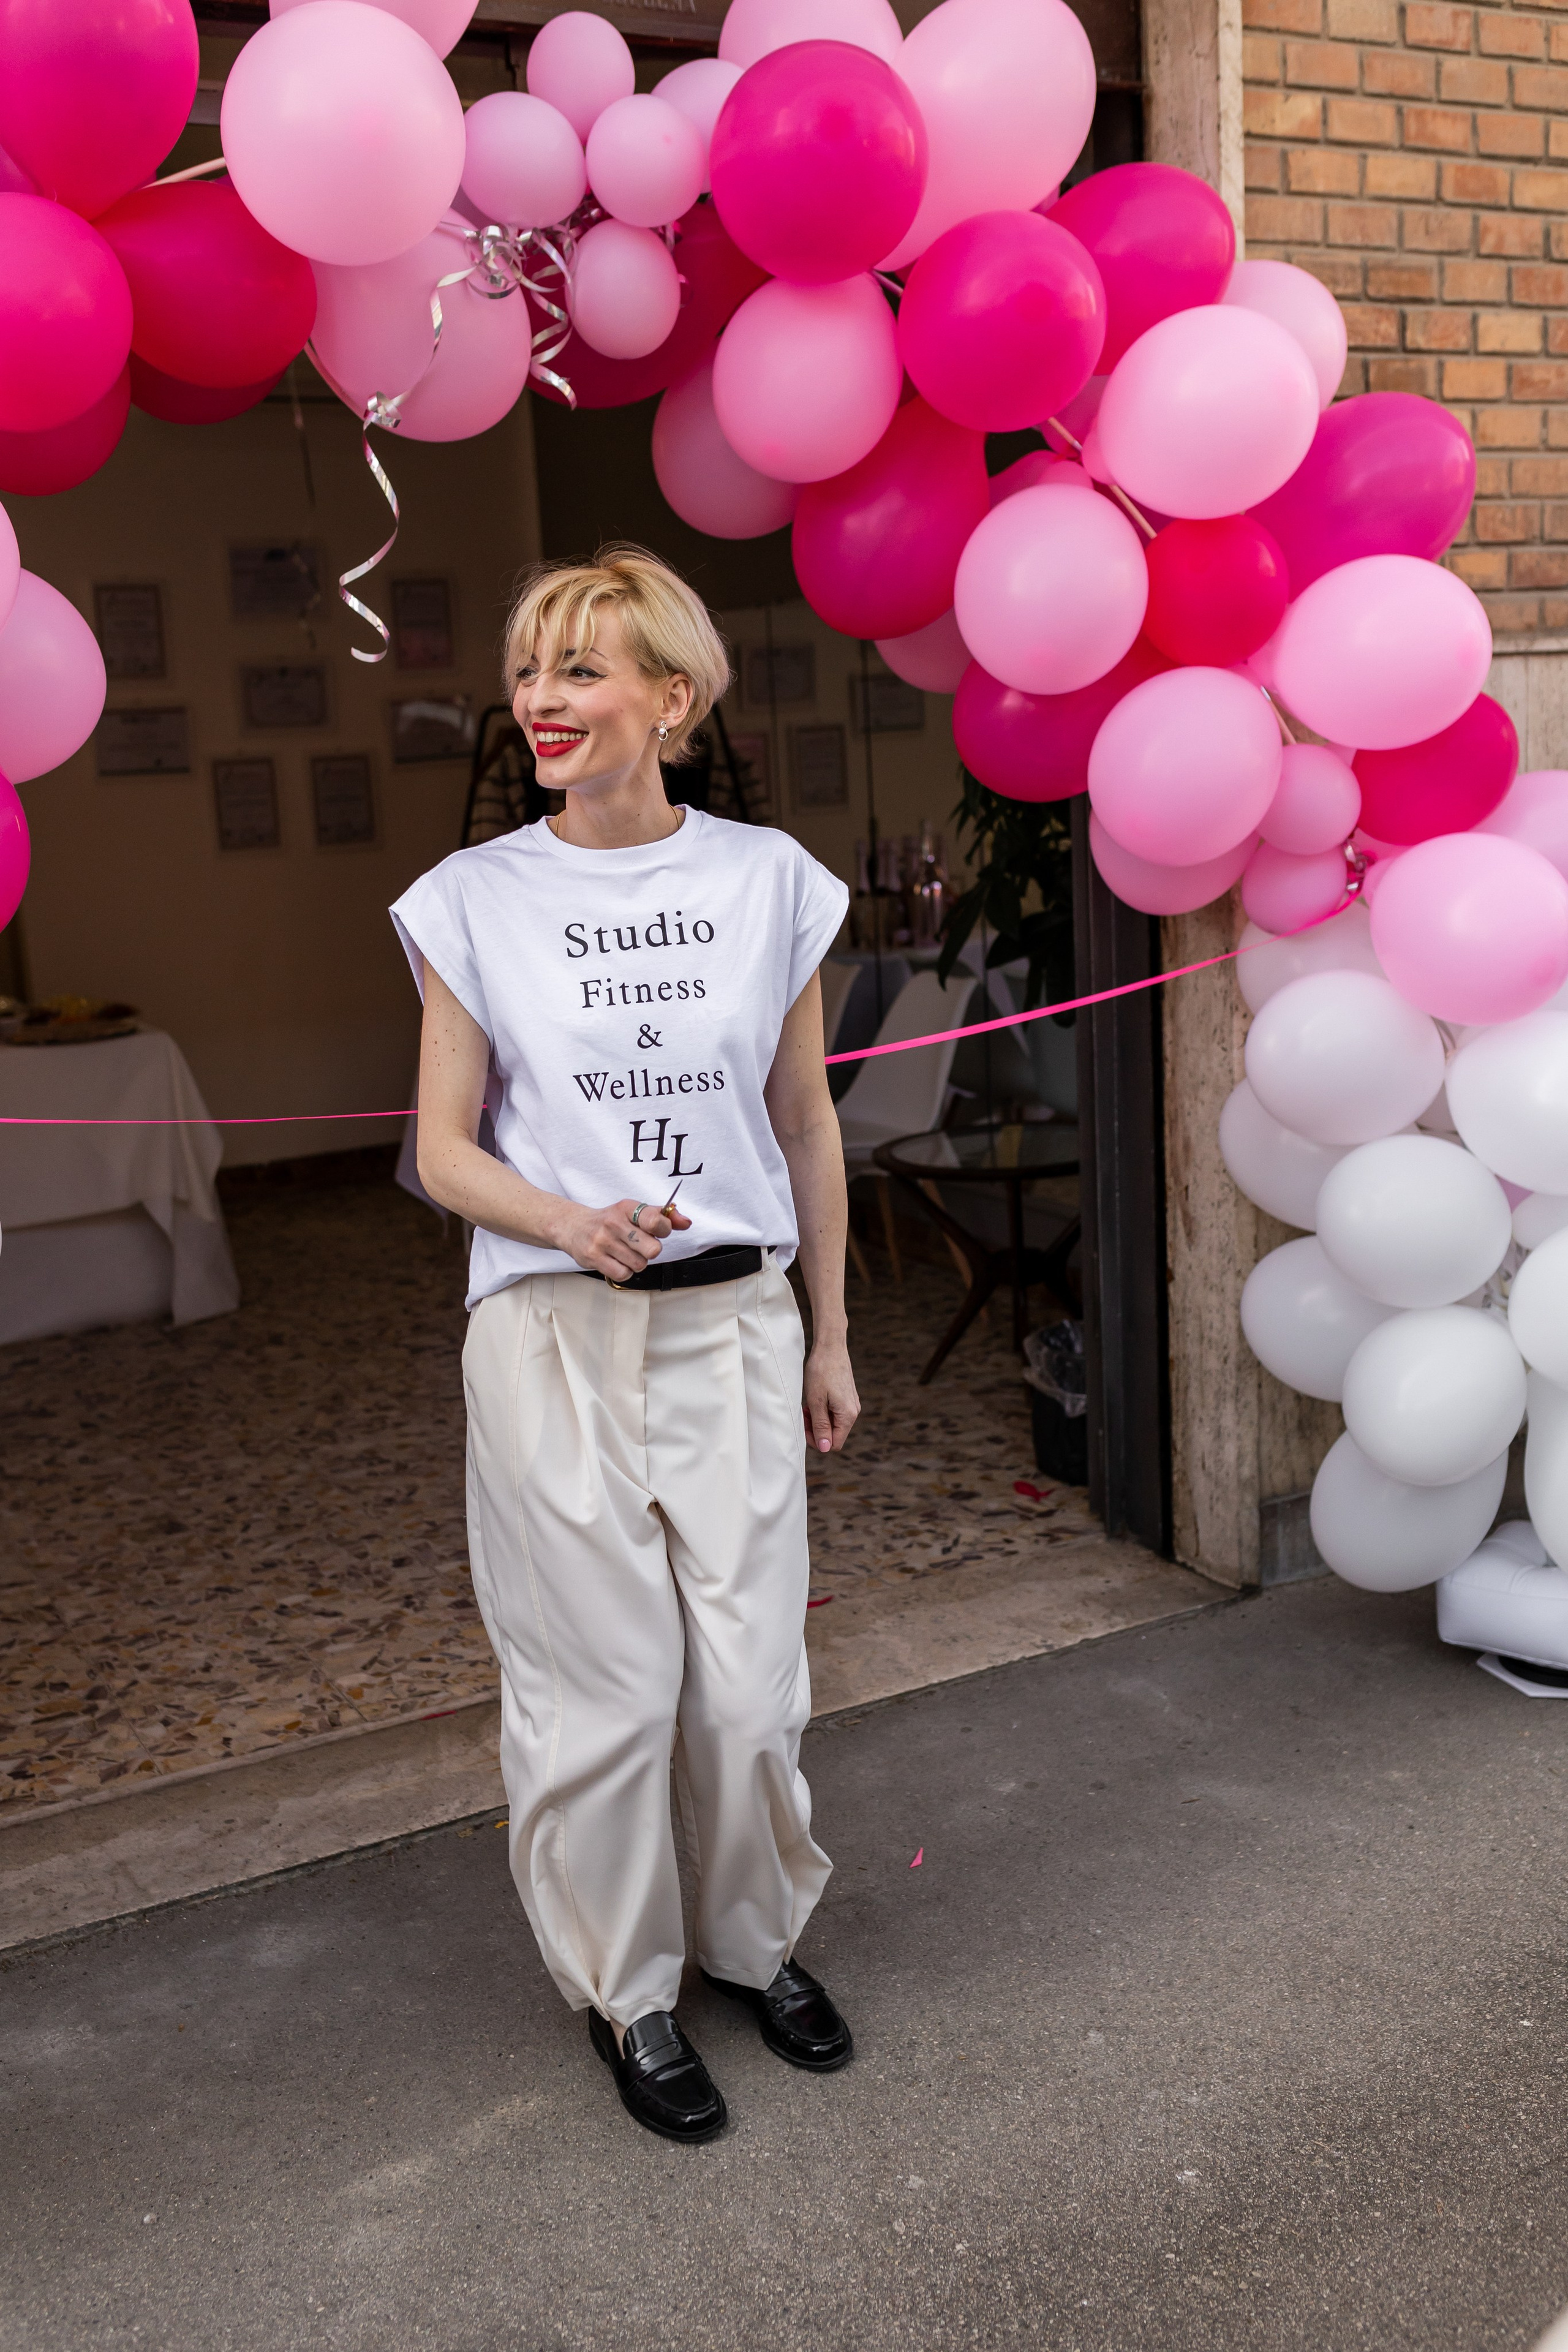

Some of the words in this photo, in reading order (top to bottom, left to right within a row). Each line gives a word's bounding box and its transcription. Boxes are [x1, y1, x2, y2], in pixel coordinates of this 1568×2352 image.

[565, 910, 714, 958] Studio
[579, 978, 706, 1008] Fitness
[637, 1023, 663, 1049] &
[572, 1068, 725, 1102] Wellness
[629, 1118, 704, 1177] HL
